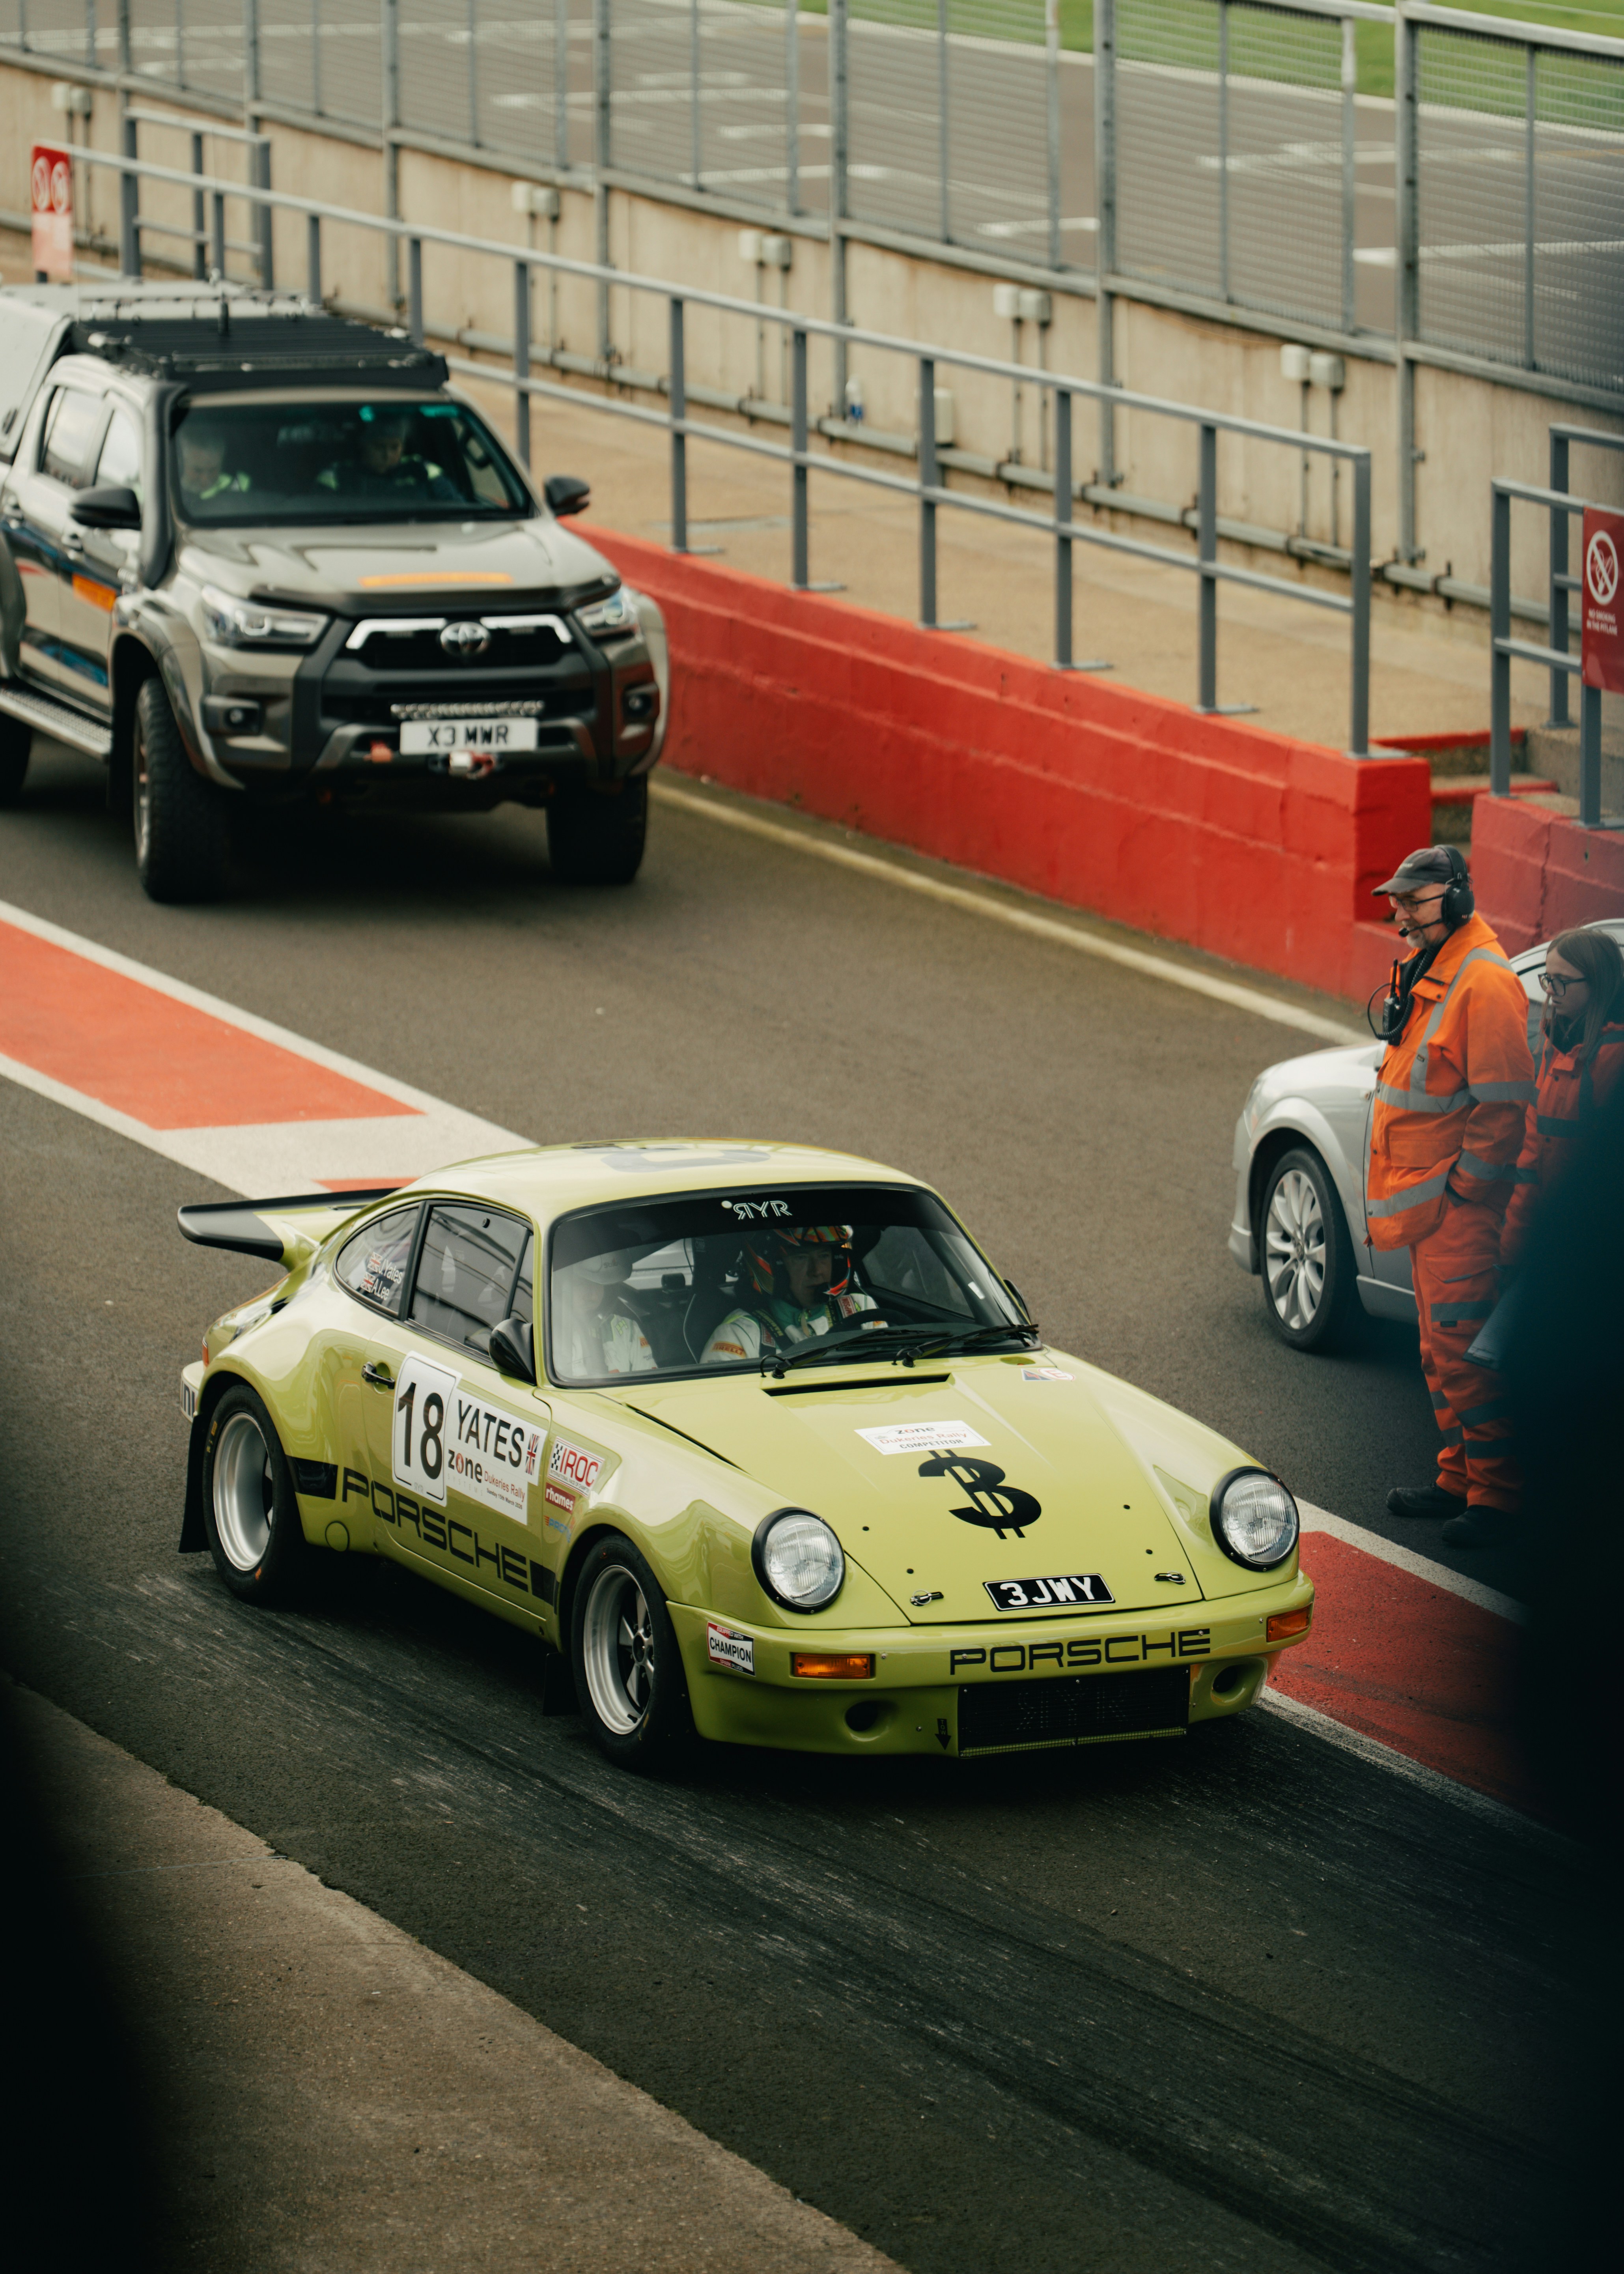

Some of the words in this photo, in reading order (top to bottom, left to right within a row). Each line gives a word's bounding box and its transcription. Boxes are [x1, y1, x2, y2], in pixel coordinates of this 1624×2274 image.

[428, 726, 455, 746] X3
[465, 724, 509, 745] MWR
[397, 1382, 444, 1480] 18
[457, 1399, 525, 1468] YATES
[879, 1434, 934, 1444] Dukeries
[899, 1439, 963, 1449] COMPETITOR
[448, 1449, 482, 1483] zone
[550, 1470, 569, 1483] INTERNATIONAL
[559, 1448, 599, 1487] IROC
[484, 1471, 509, 1492] Dukeries
[511, 1484, 525, 1502] Rally
[486, 1488, 497, 1498] Sunday
[546, 1487, 573, 1511] rhames
[342, 1467, 528, 1593] PORSCHE
[716, 1626, 734, 1637] EQUIPPED
[710, 1637, 751, 1663] CHAMPION
[950, 1628, 1210, 1675] PORSCHE
[720, 1659, 732, 1668] SPARK
